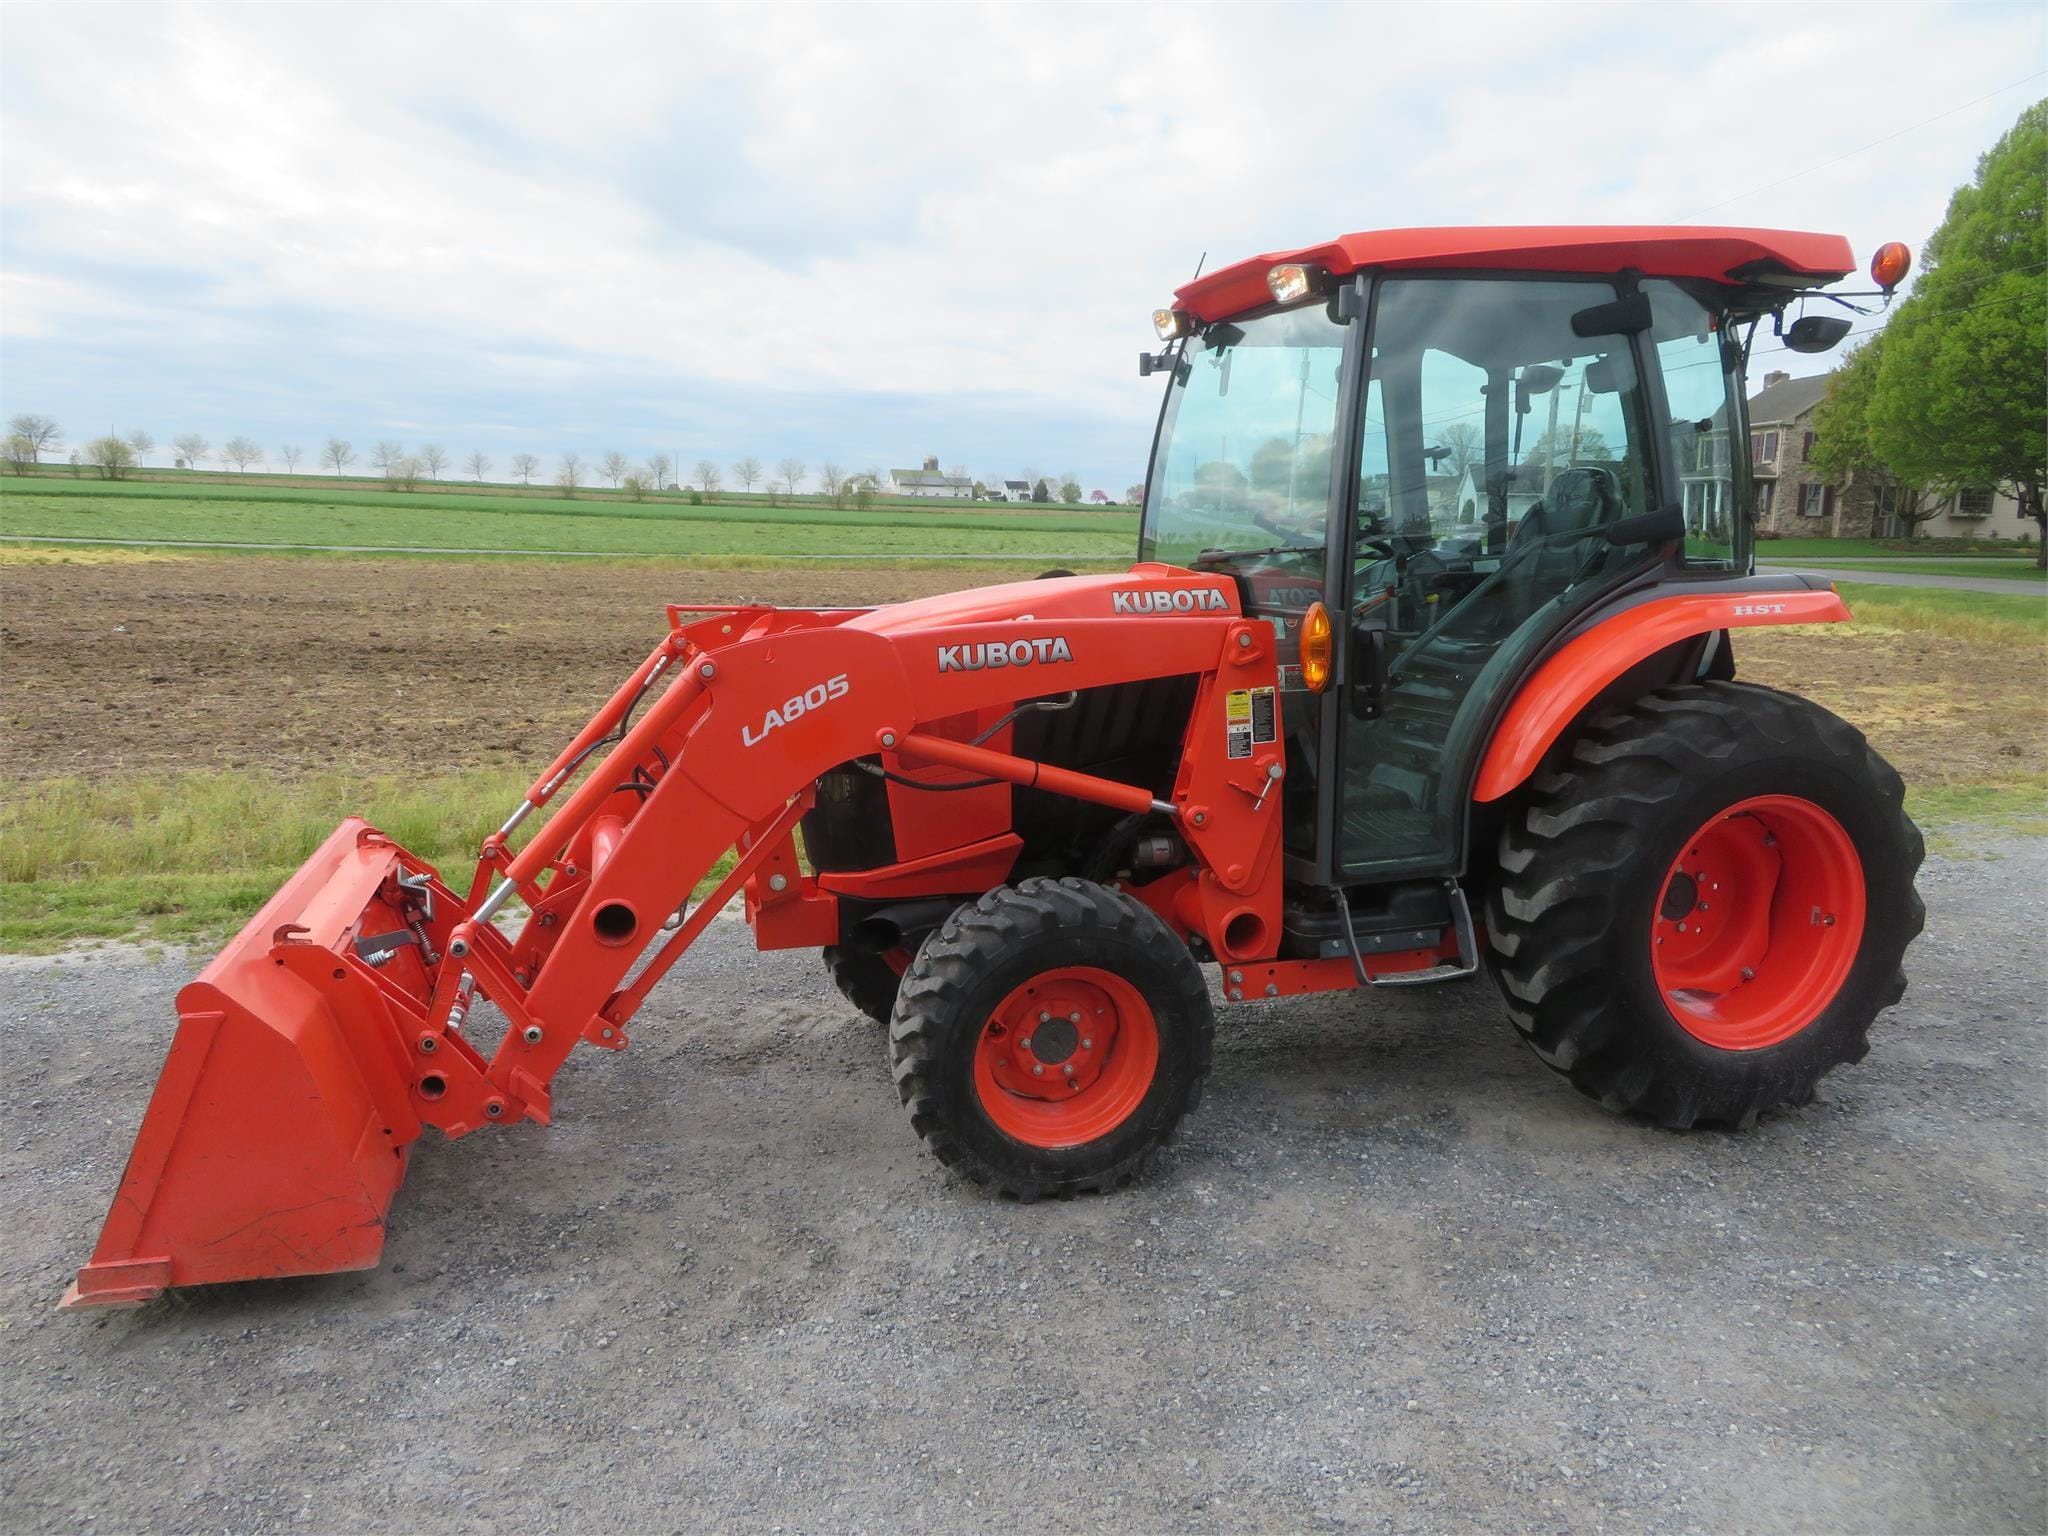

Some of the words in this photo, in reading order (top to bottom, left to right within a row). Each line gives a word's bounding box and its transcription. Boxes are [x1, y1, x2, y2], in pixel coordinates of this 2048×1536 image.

[1112, 588, 1229, 614] KUBOTA
[1733, 604, 1786, 616] HST
[938, 636, 1074, 673] KUBOTA
[741, 673, 850, 748] LA805
